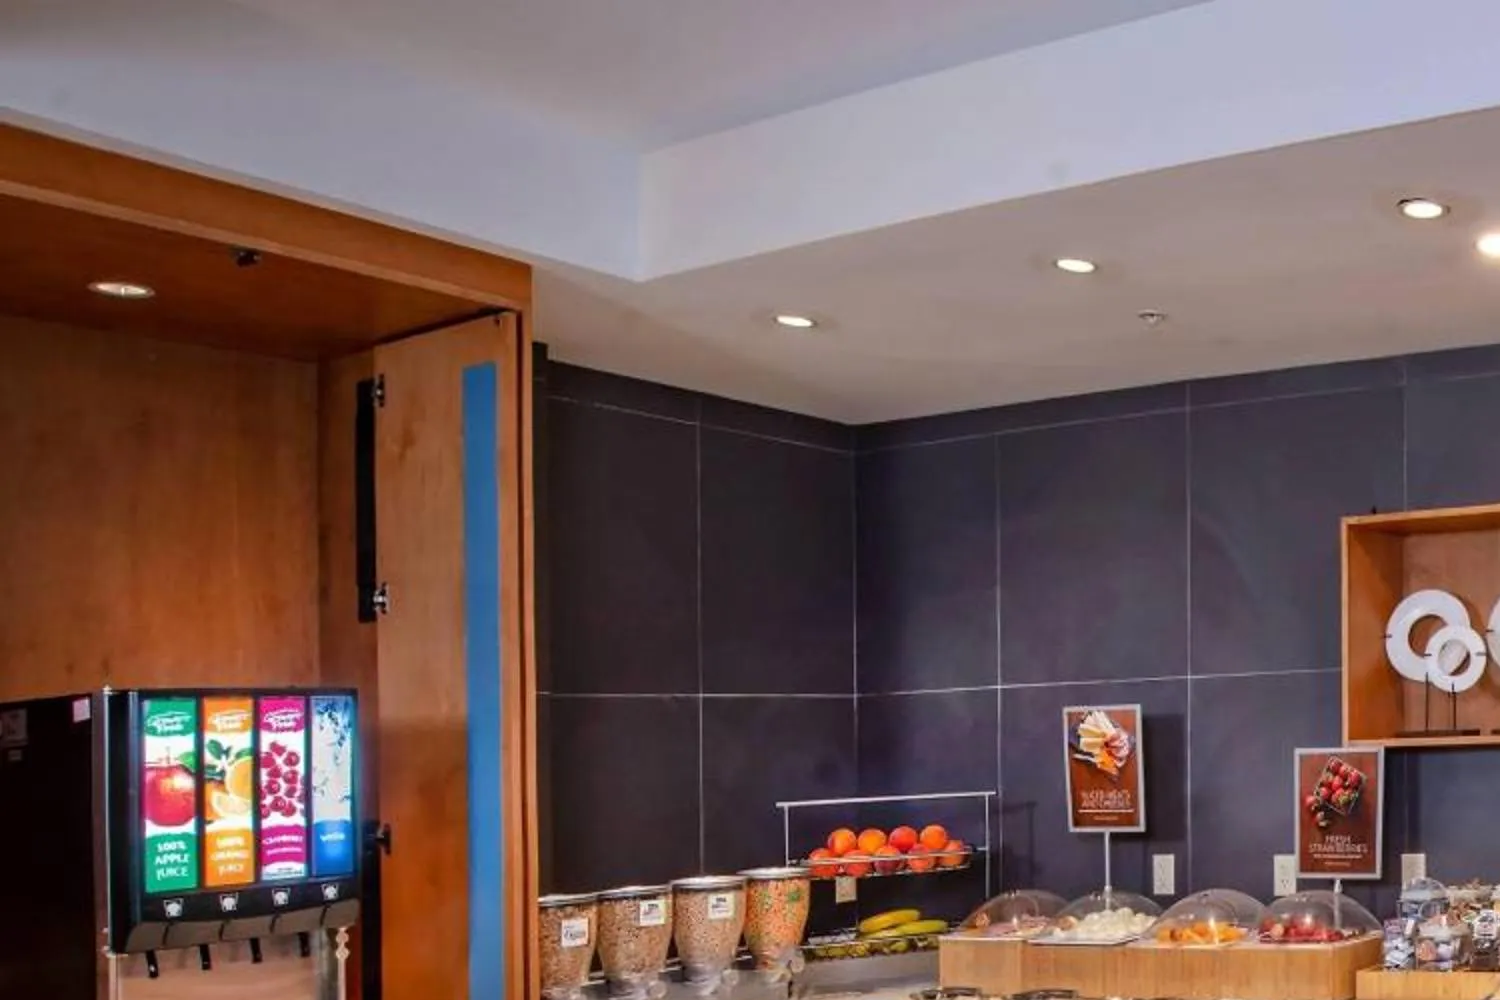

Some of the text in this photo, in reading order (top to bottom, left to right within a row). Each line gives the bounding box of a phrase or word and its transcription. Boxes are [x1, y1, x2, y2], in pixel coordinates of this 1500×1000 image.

[157, 840, 187, 853] 100%
[155, 853, 190, 865] APPLE
[156, 865, 190, 881] JUICE
